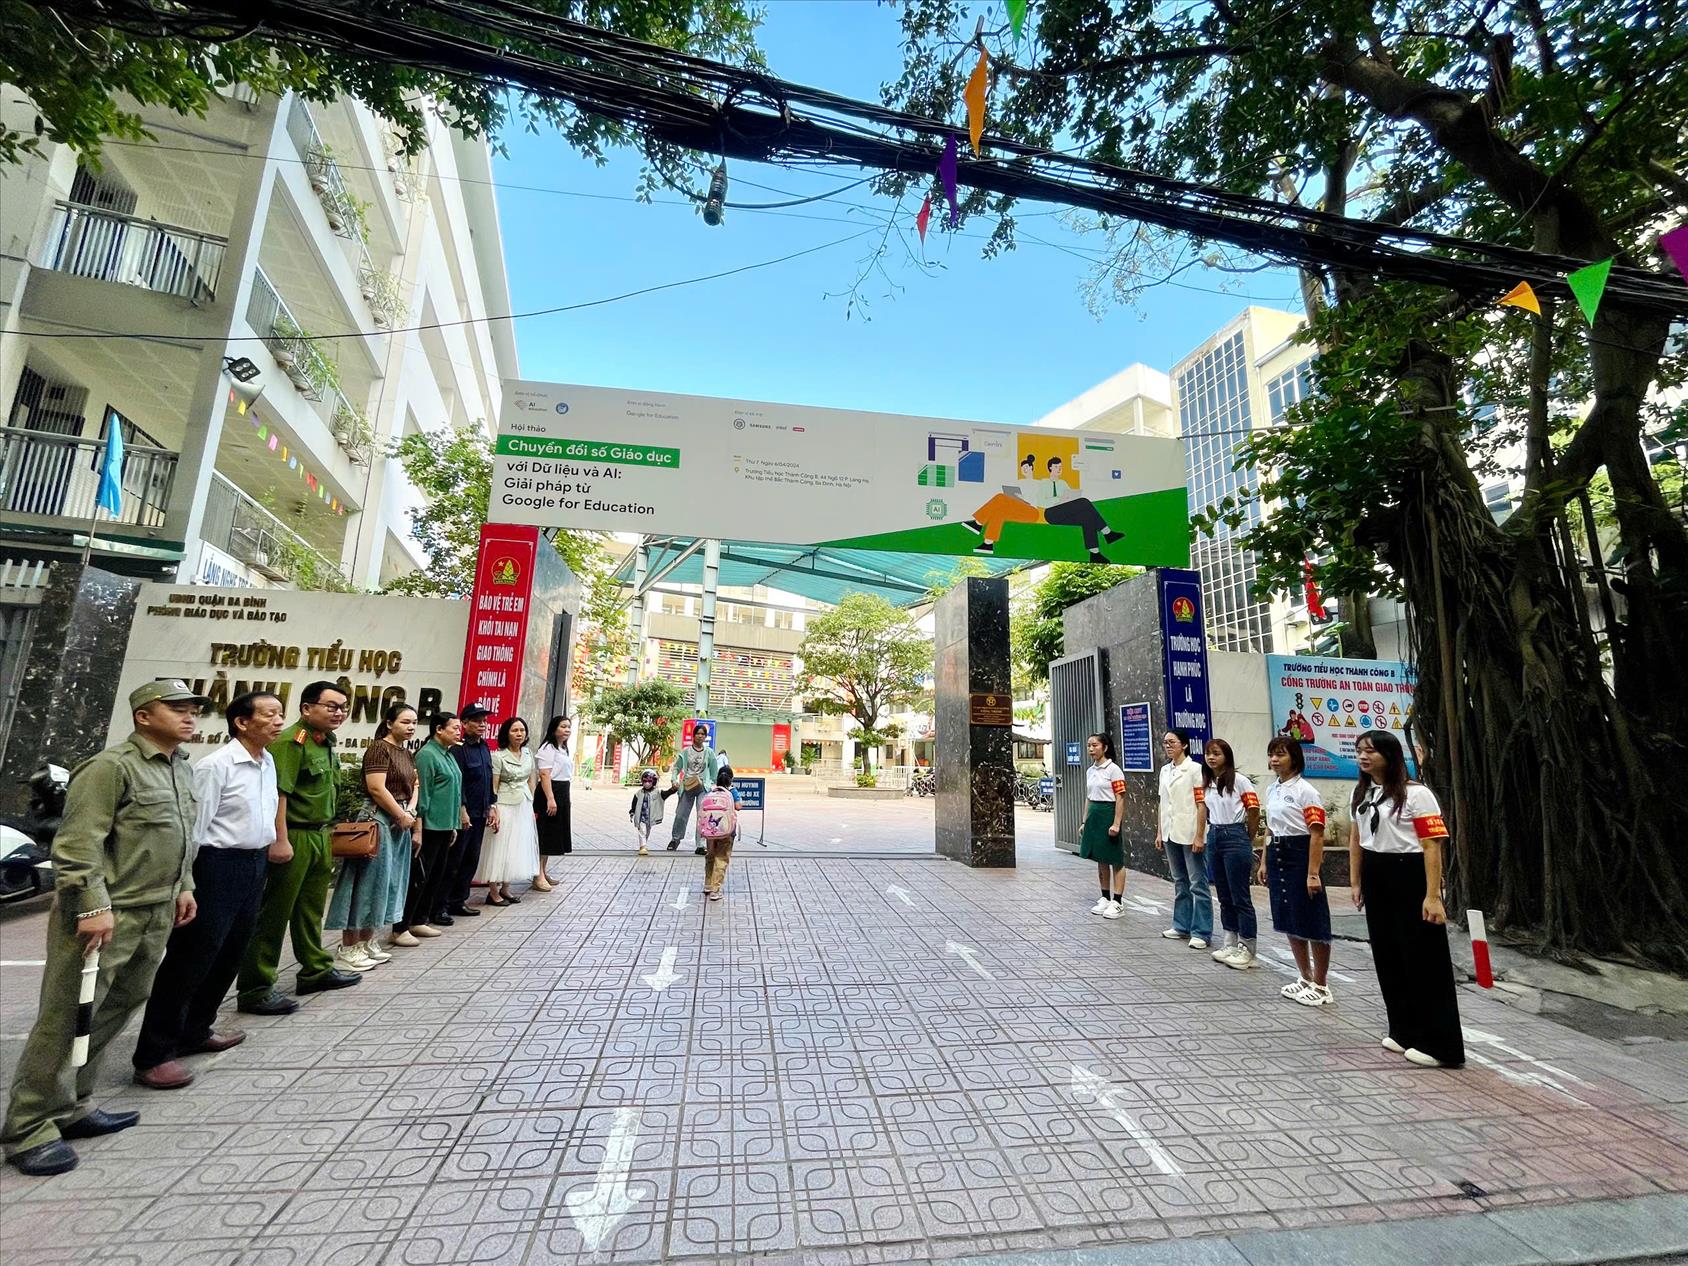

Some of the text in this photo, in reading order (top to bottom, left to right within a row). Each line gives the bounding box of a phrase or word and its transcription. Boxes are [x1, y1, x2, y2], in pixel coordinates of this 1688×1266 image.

[511, 424, 546, 433] Hội thảo
[508, 440, 672, 466] Chuyển đổi số Giáo dục
[506, 461, 622, 479] với Dữ liệu và AI:
[504, 477, 591, 494] Giải pháp từ
[502, 494, 655, 515] Google for Education
[198, 594, 225, 607] QUẬN
[227, 596, 241, 607] BA
[479, 590, 525, 614] BẢO VỆ TRẺ EM
[184, 606, 207, 619] GIÁO
[209, 608, 229, 621] DỤC
[232, 608, 245, 620] VÀ
[269, 611, 287, 623] TẠO
[478, 615, 519, 640] KHỎI TAI NẠN
[476, 643, 514, 662] GIAO THÔNG
[1170, 632, 1201, 656] TRƯỜNG HỌC
[210, 638, 402, 679] TRƯỜNG TIỂU HỌC
[477, 668, 507, 687] CHÍNH LÀ
[1173, 658, 1201, 680] HẠNH PHÚC
[1283, 661, 1396, 677] TRƯỜNG TIỂU HỌC THÀNH CÔNG B
[1185, 684, 1193, 703] LÀ
[1305, 676, 1338, 690] TRƯỜNG
[1339, 680, 1351, 690] AN
[1352, 679, 1374, 692] TOÀN
[1375, 682, 1393, 693] GIAO
[1175, 708, 1206, 732] TRƯỜNG HỌC
[345, 738, 358, 748] BA
